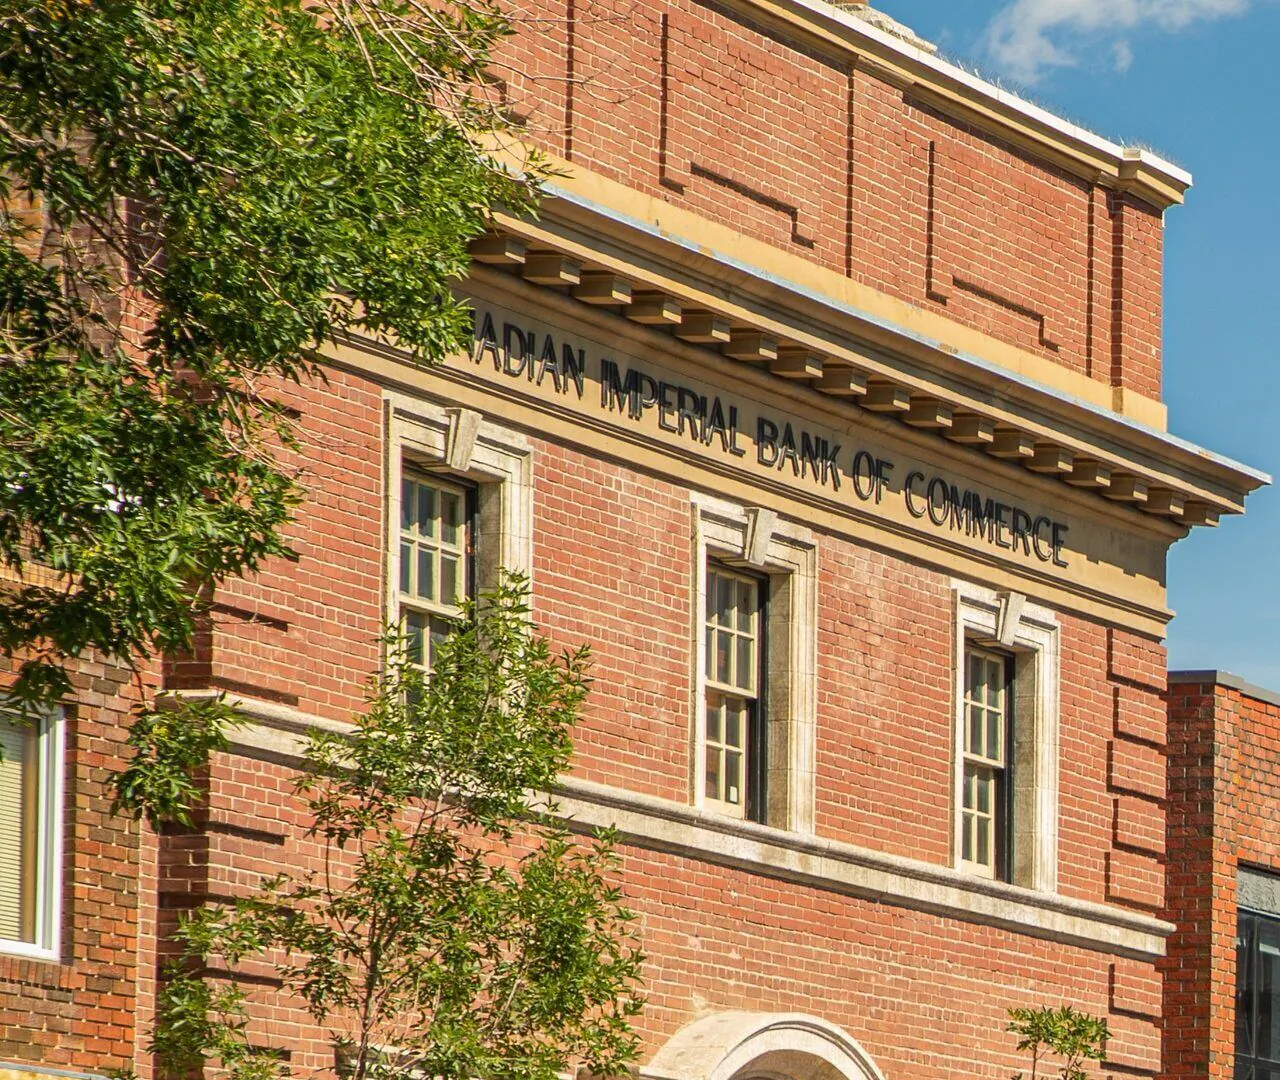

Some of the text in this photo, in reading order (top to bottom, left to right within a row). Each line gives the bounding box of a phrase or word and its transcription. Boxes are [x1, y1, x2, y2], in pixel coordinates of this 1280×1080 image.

[601, 358, 746, 458] IMPERIAL
[757, 416, 843, 493] BANK
[852, 450, 894, 505] OF
[905, 470, 1069, 569] COMMERCE
